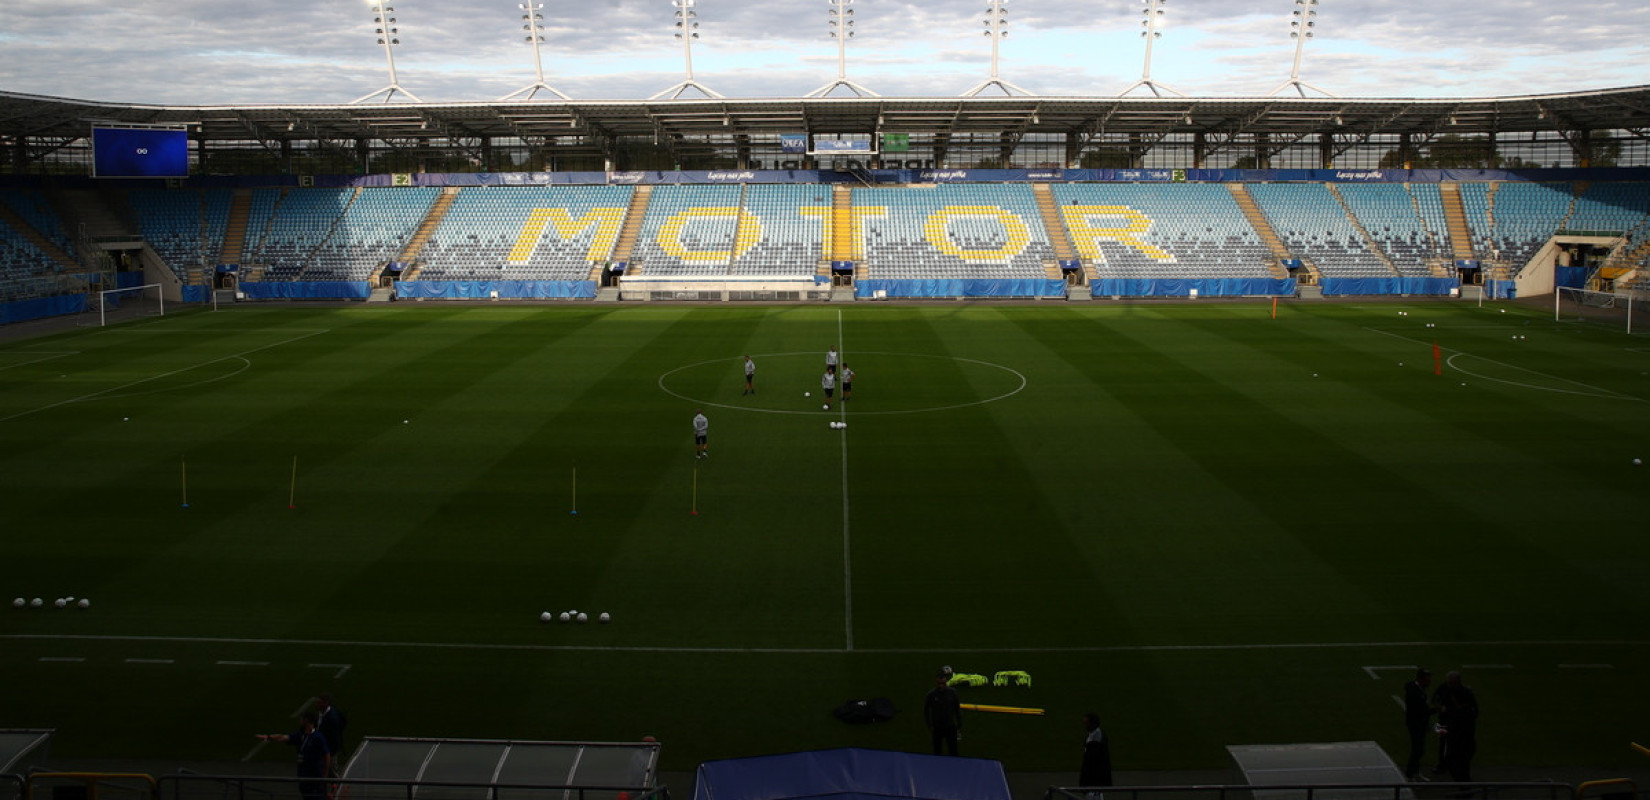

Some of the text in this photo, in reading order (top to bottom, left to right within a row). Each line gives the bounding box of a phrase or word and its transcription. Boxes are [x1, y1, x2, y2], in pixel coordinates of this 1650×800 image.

[781, 139, 804, 148] UEFA
[395, 174, 408, 185] E2
[1172, 170, 1185, 181] F3
[506, 205, 1178, 266] MOTOR
